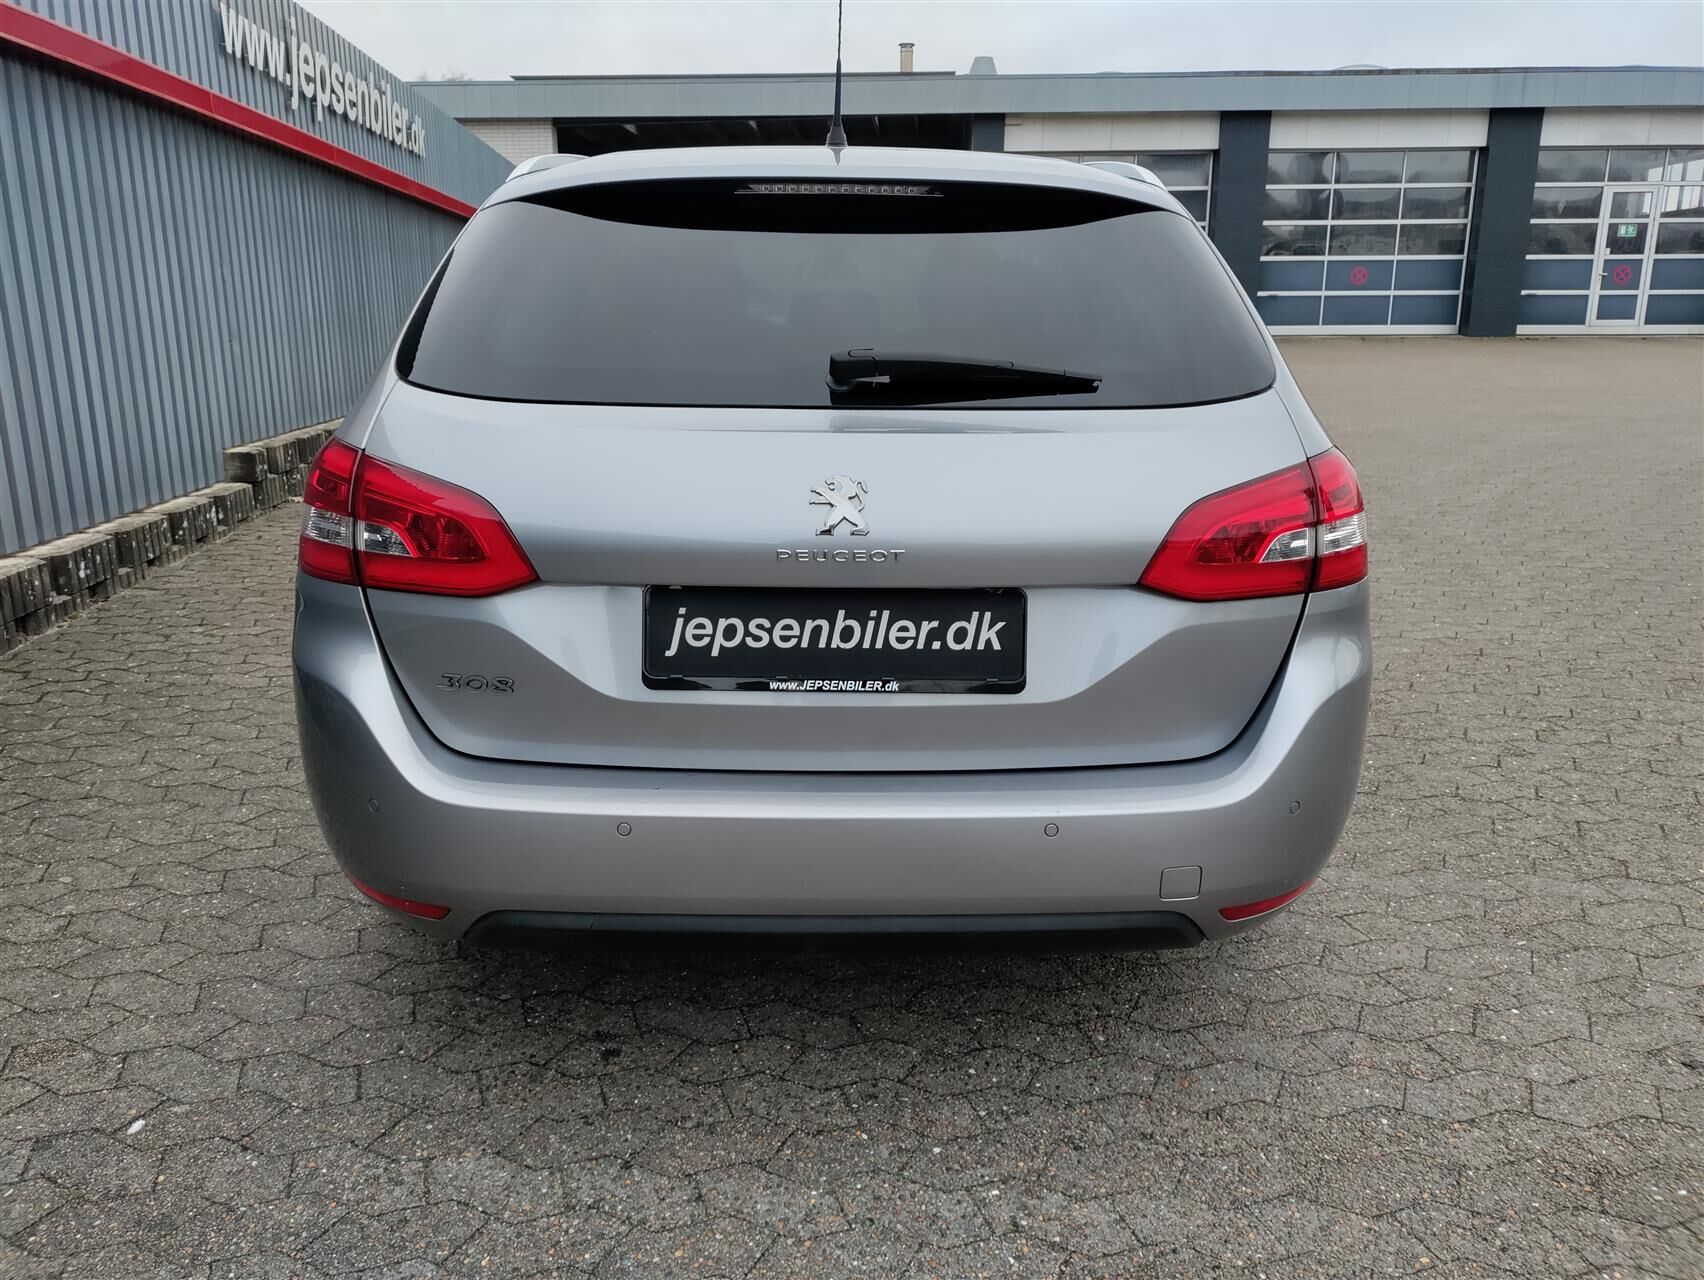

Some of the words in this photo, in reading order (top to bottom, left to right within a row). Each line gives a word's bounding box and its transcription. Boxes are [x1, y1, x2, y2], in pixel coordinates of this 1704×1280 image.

[220, 2, 425, 157] www.jepsenbiler.dk
[776, 549, 906, 562] PEUGEOT
[664, 607, 1006, 657] jepsenbiler.dk
[438, 672, 515, 694] 308
[769, 680, 900, 692] www.JEPSENBILER.dk
